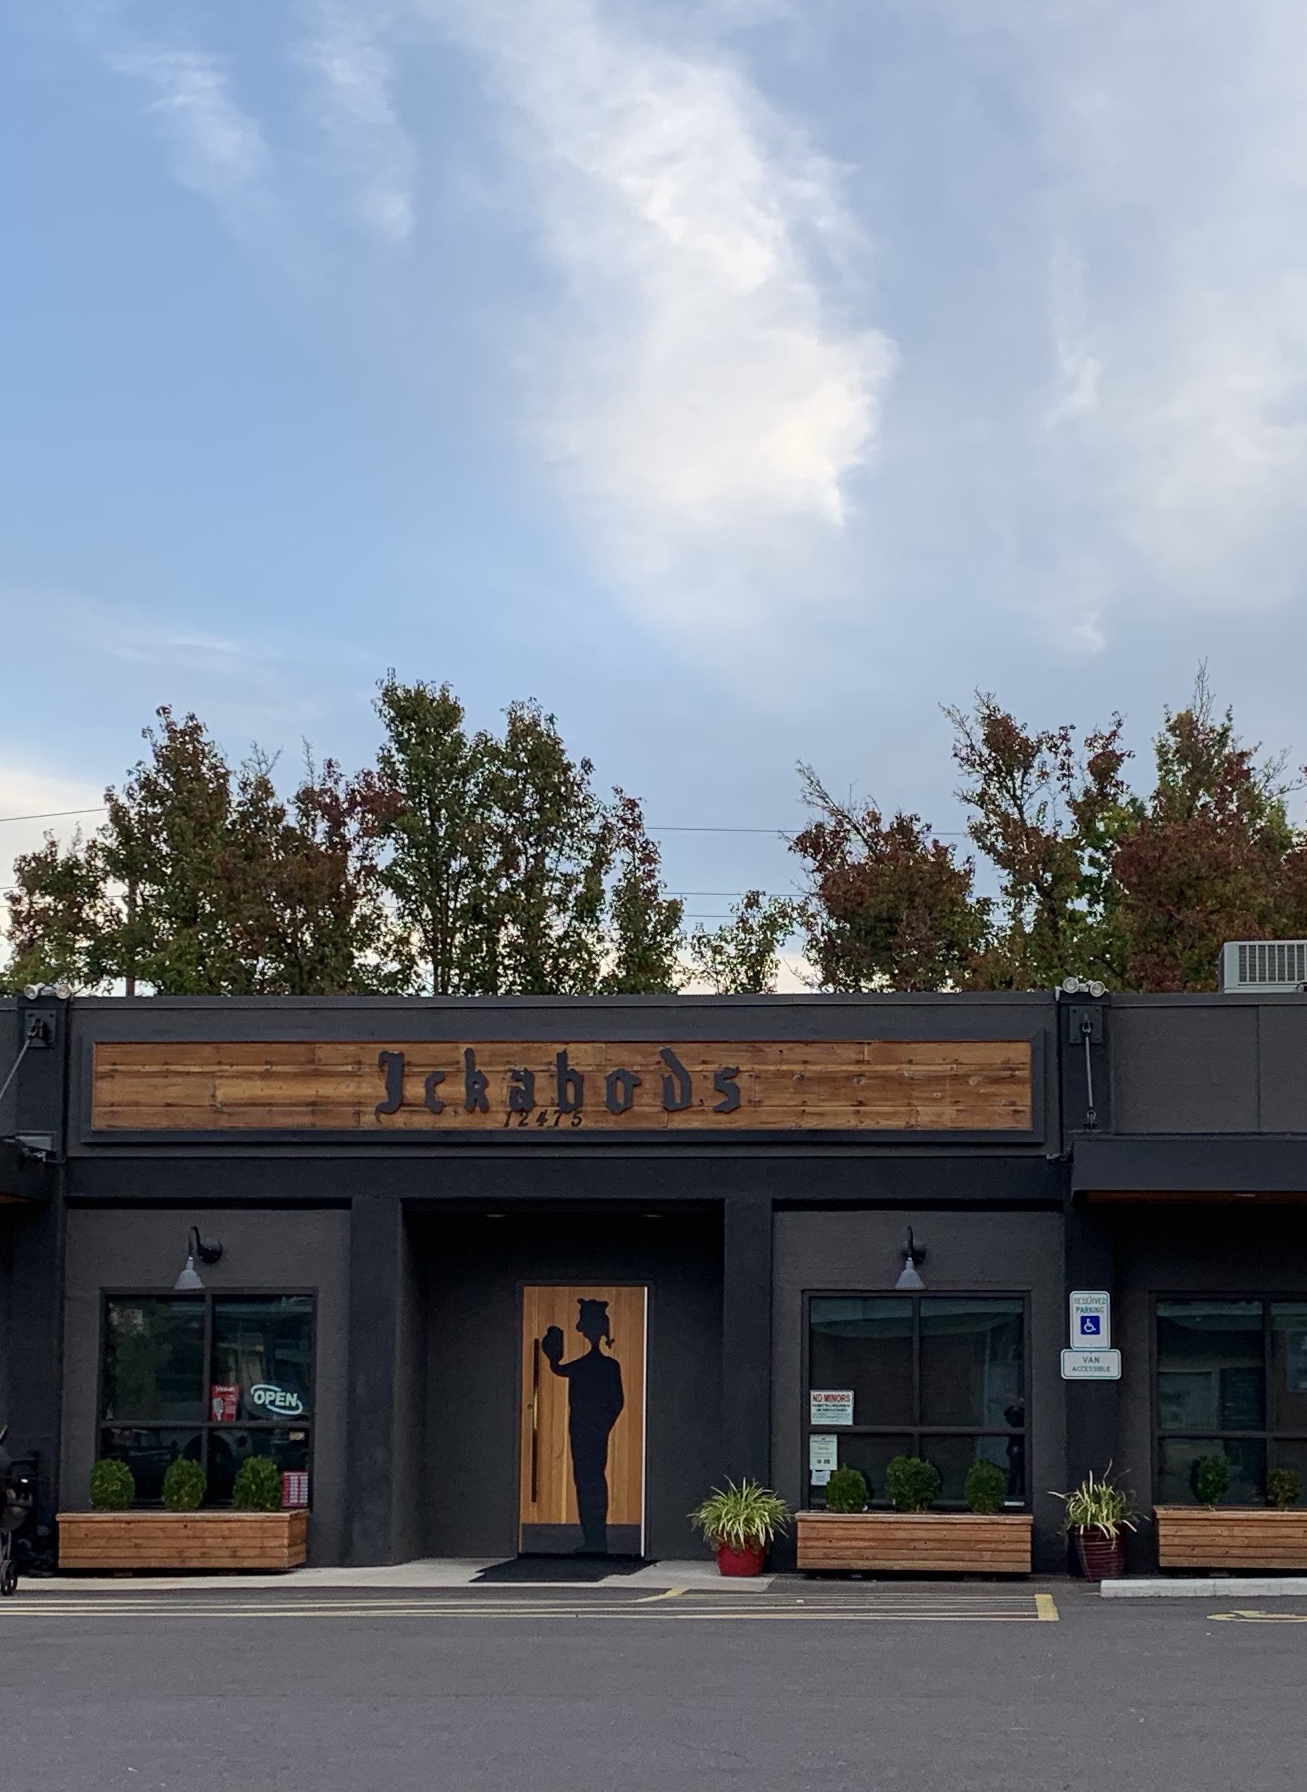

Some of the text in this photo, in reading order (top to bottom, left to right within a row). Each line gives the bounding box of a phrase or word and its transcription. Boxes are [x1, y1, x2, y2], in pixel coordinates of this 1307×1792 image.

[503, 1108, 584, 1128] 12475
[1073, 1296, 1108, 1305] RESERVED
[1075, 1306, 1105, 1314] PARKING
[1082, 1356, 1100, 1364] VAN
[253, 1390, 298, 1407] OPEN
